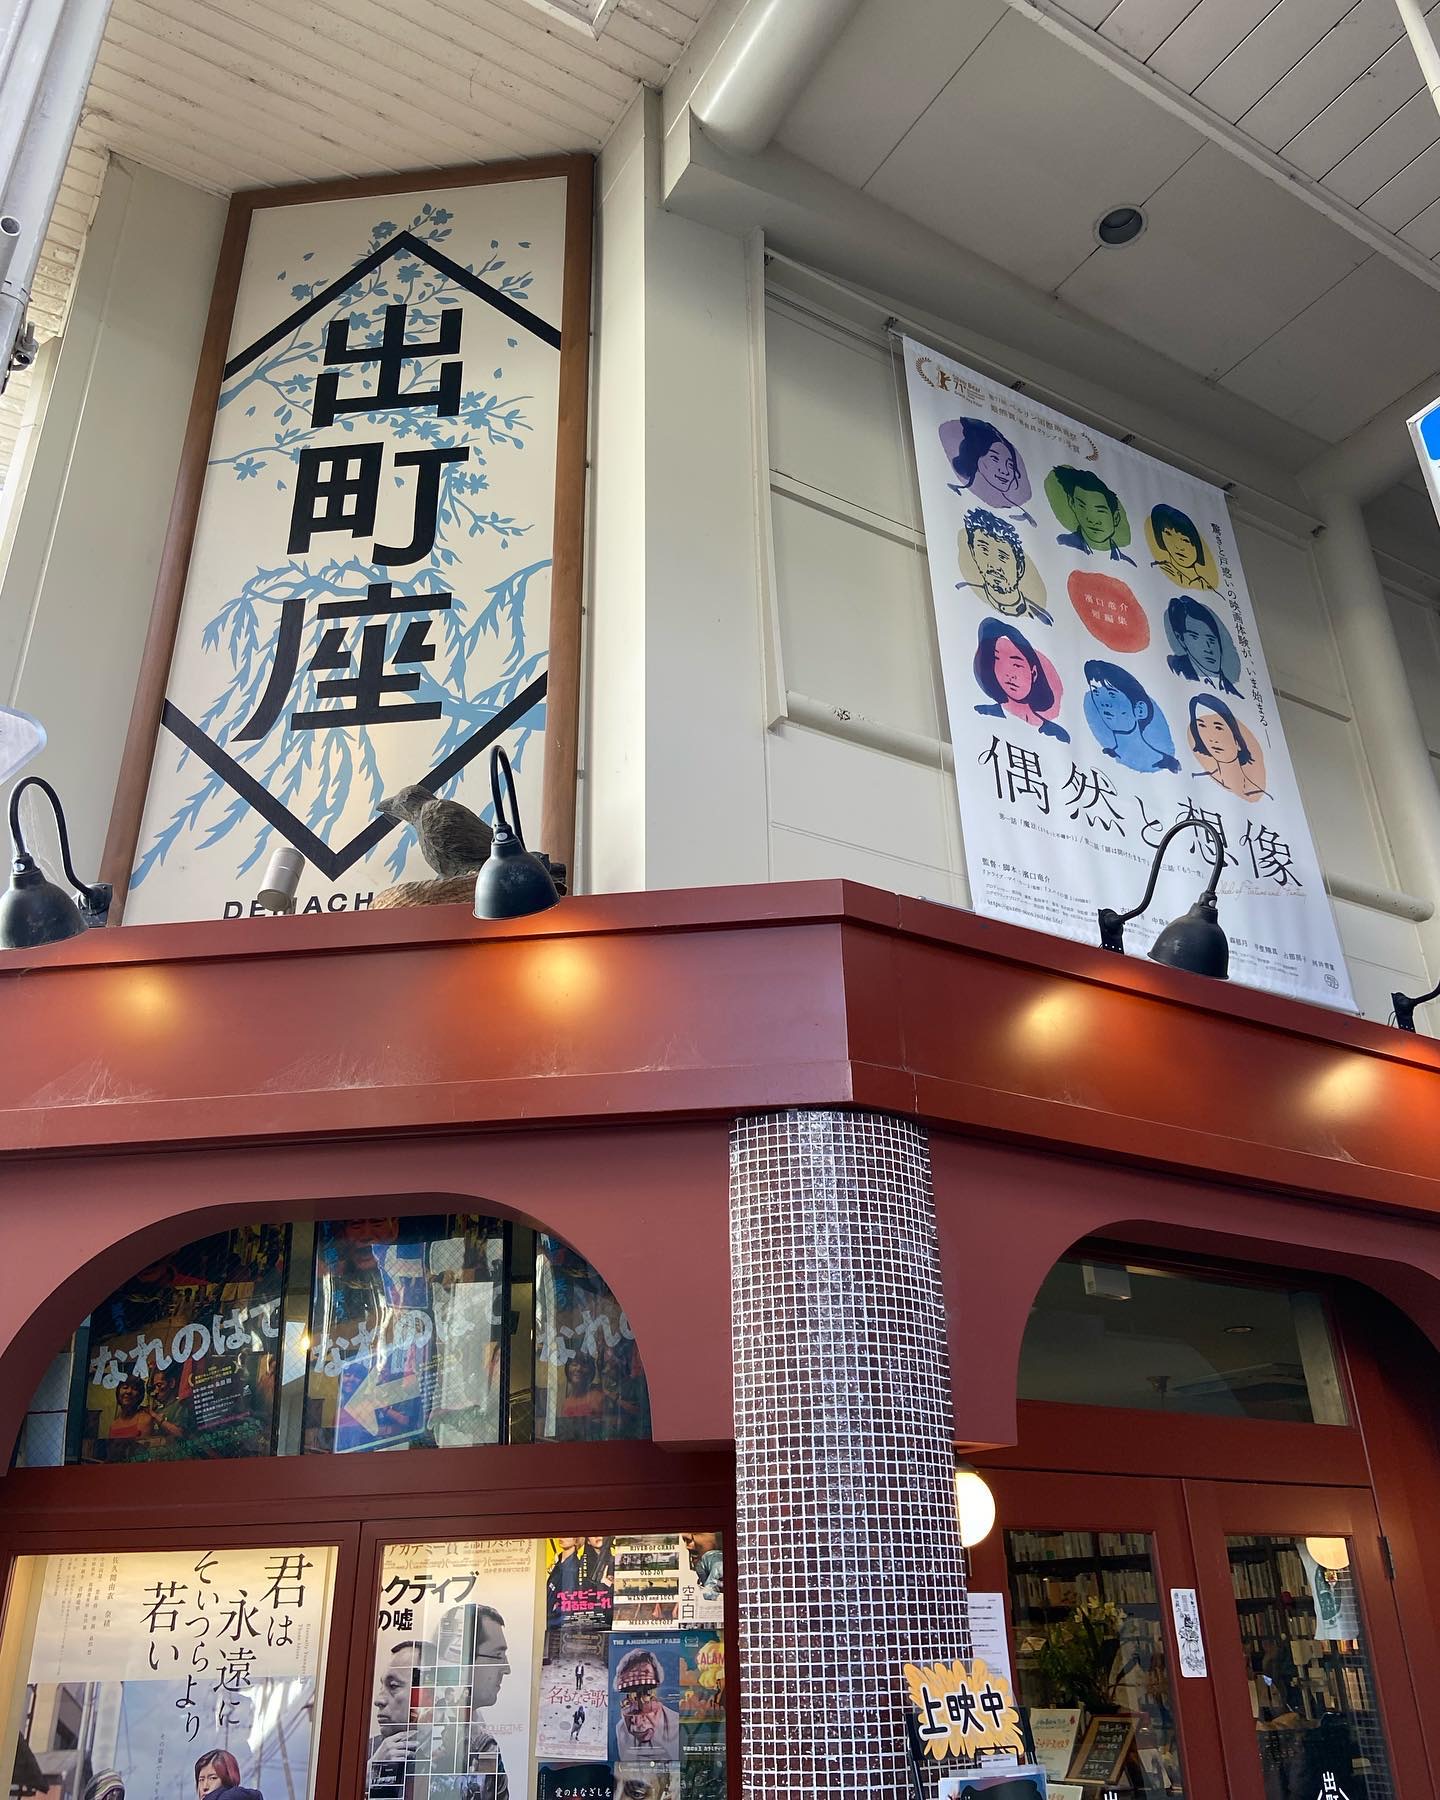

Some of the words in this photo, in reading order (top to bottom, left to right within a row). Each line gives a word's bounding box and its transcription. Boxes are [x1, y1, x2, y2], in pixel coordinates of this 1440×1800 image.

[231, 303, 470, 742] 出町座
[978, 735, 1302, 887] 偶然と想像
[223, 892, 374, 919] DEACH
[90, 1298, 281, 1389] なれのはて
[260, 1553, 313, 1647] 君は
[378, 1608, 414, 1631] の嘘
[381, 1570, 479, 1606] クティブ
[682, 1585, 694, 1619] 空白
[140, 1581, 188, 1671] 若い
[175, 1550, 220, 1743] そいつらより
[213, 1589, 261, 1726] 永遠に
[549, 1685, 608, 1708] 名もなき歌
[922, 1683, 1004, 1735] 上映中
[555, 1787, 612, 1798] 愛のまなざしを
